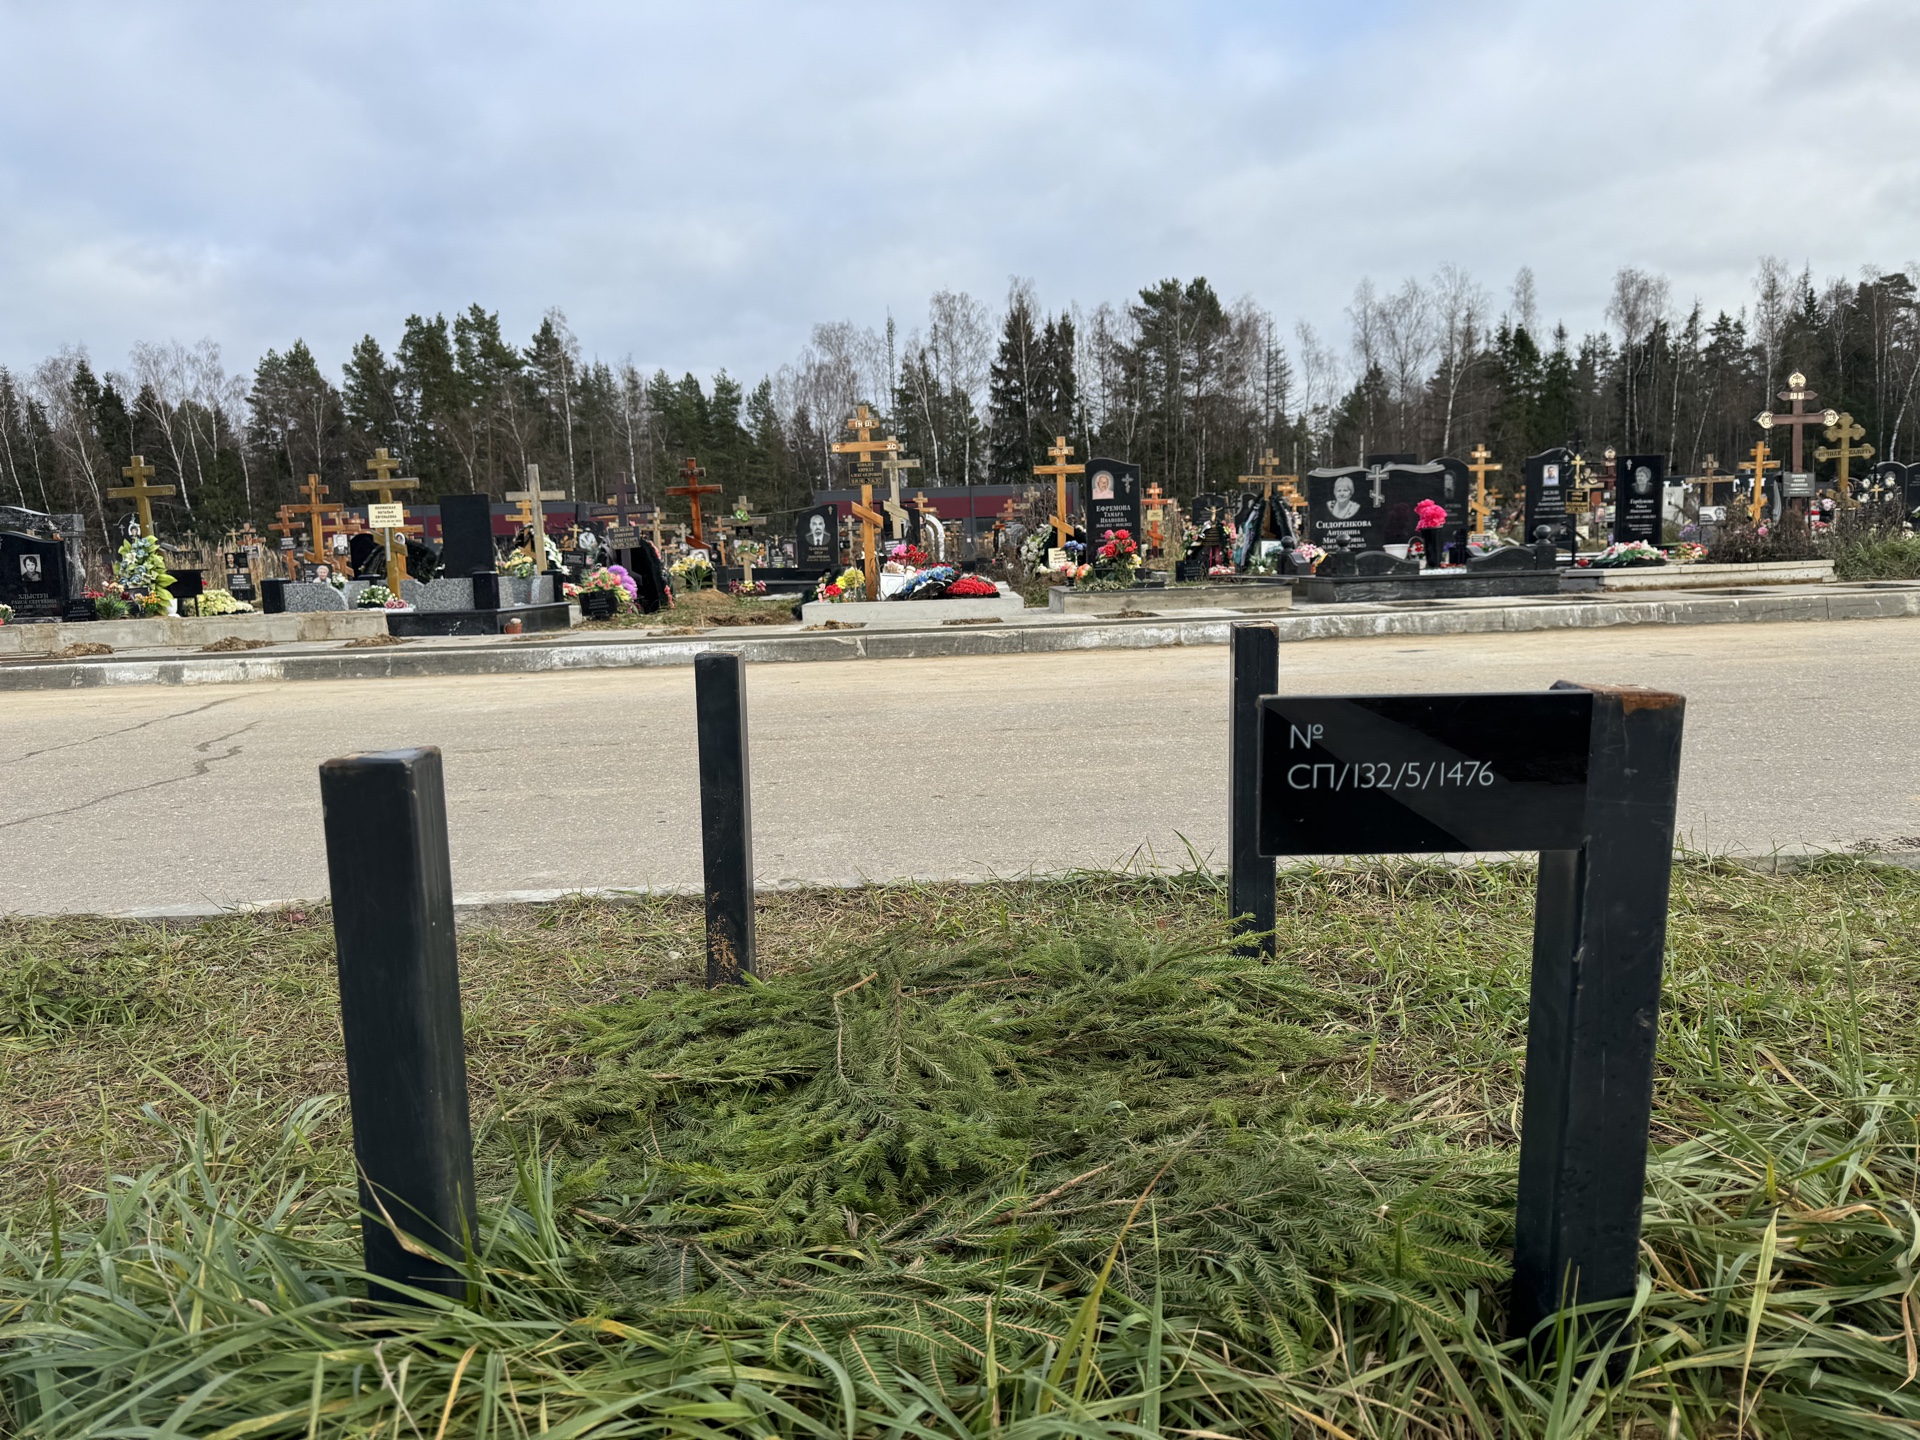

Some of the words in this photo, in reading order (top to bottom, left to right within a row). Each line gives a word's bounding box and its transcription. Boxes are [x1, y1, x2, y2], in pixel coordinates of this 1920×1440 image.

[1316, 520, 1372, 529] СИДОРЕНКОВА
[1289, 723, 1324, 750] №
[1287, 760, 1495, 791] СП/132/5/1476
